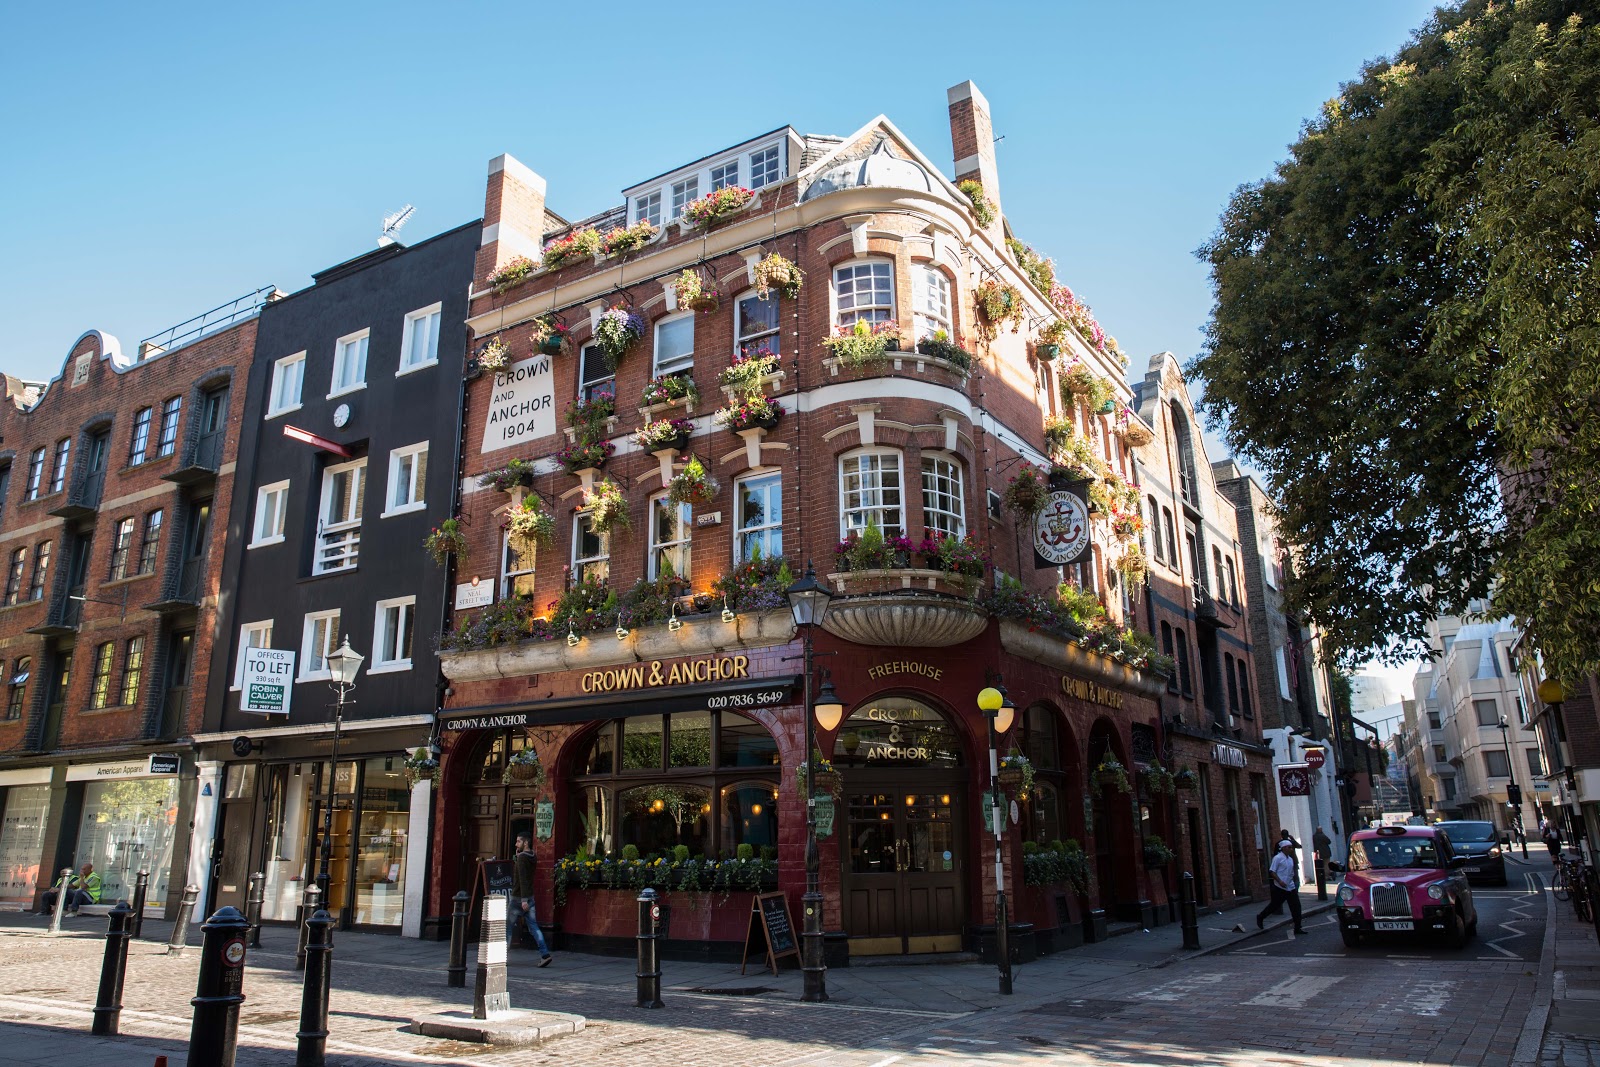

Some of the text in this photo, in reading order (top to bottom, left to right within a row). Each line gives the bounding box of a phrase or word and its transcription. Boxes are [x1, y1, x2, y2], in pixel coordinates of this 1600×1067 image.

[497, 359, 549, 387] CROWN
[493, 390, 515, 404] AND
[489, 394, 552, 424] ANCHOR
[503, 419, 535, 440] 1904
[1036, 536, 1087, 562] AND ANCHOR
[458, 597, 479, 606] STREET
[467, 590, 482, 598] NEAL
[257, 651, 285, 660] OFFICES
[249, 660, 291, 675] TO LET
[581, 655, 749, 694] CROWN & ANCHOR
[867, 661, 943, 681] FREEHOUSE
[250, 692, 283, 700] CALVER
[251, 684, 279, 693] ROBIN
[1061, 675, 1123, 710] CROWN & ANCHOR
[708, 691, 783, 709] 020 7836 5649
[868, 708, 923, 720] CROWN
[447, 714, 527, 730] CROWN & ANCHOR
[888, 724, 905, 743] &
[235, 740, 249, 751] 24
[866, 747, 928, 759] ANCHOR
[97, 765, 143, 775] American Apparel
